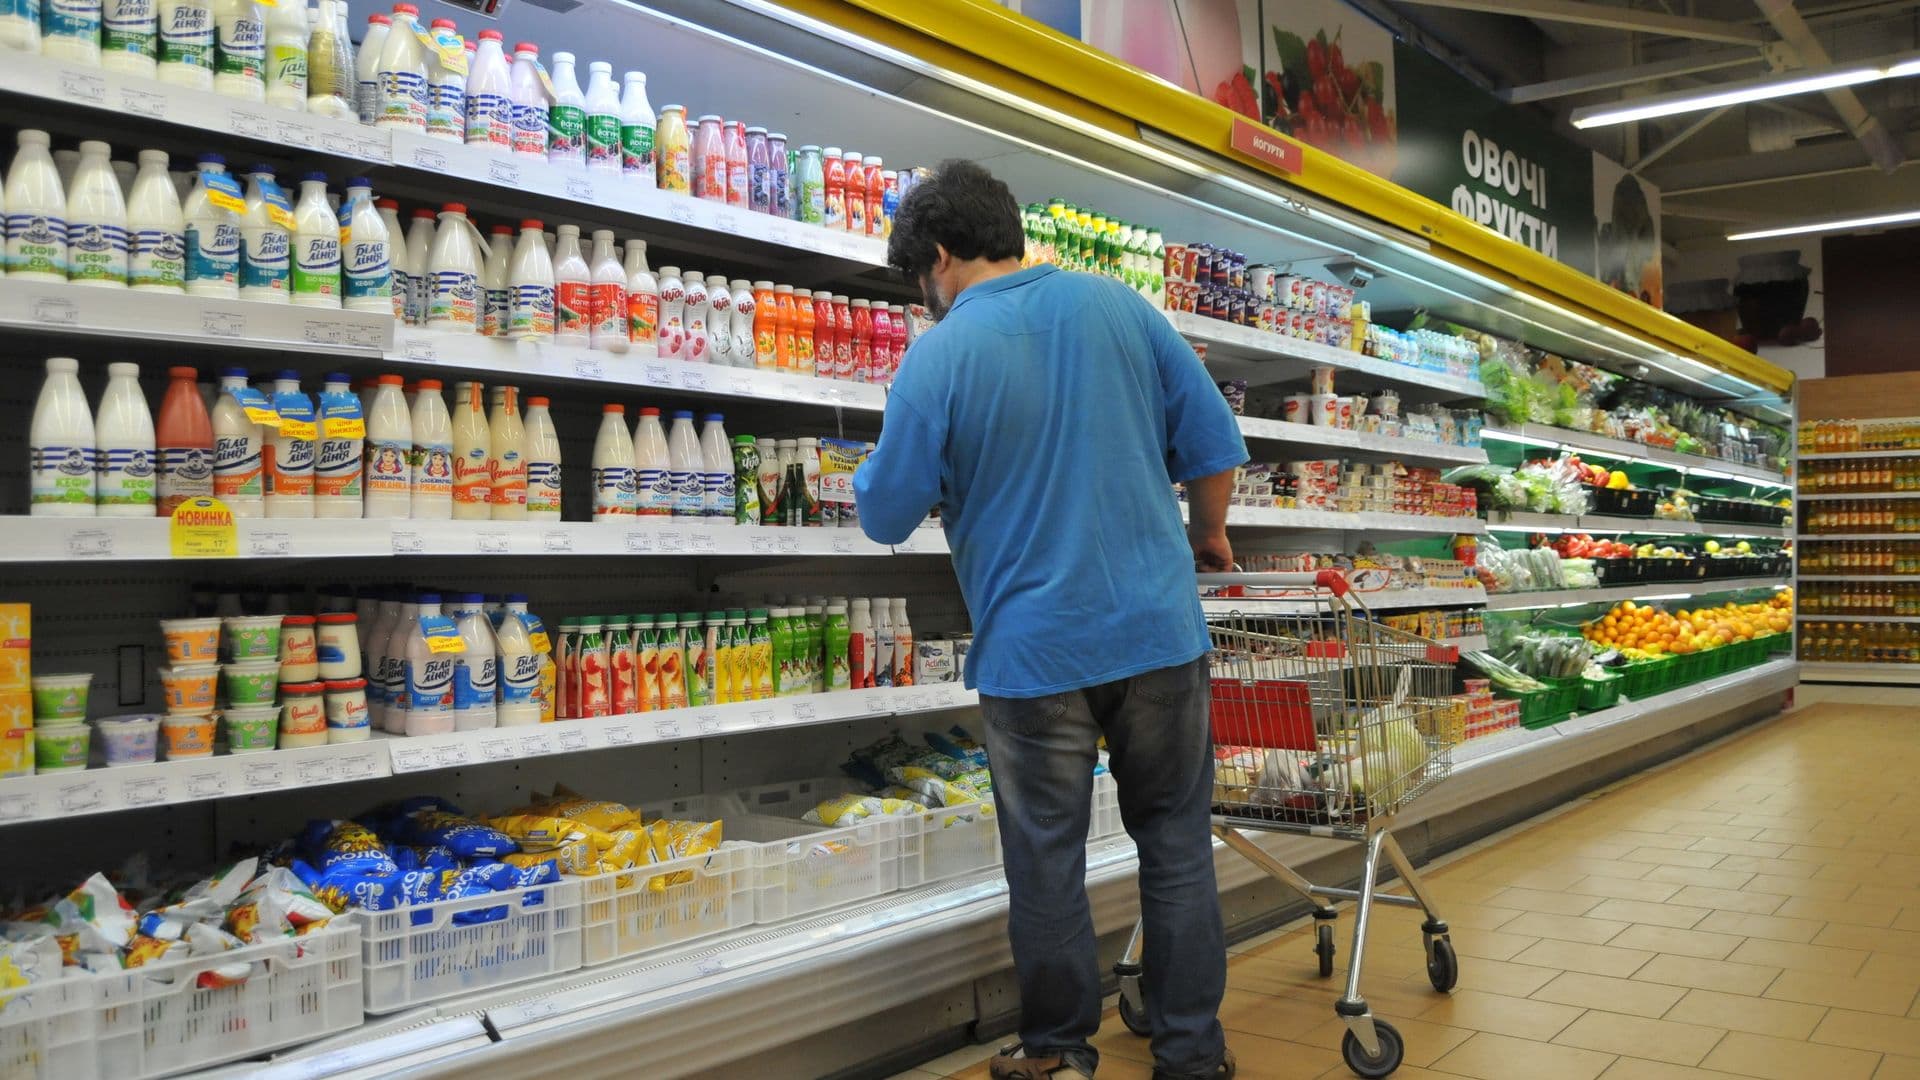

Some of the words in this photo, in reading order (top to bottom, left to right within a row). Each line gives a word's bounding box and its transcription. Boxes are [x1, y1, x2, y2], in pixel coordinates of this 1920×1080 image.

[1253, 136, 1285, 160] ЙОГУРТИ
[1463, 130, 1547, 209] ОВОЧІ
[263, 232, 289, 244] Біла
[20, 244, 58, 257] КЕФІР
[259, 243, 288, 256] лінія
[310, 239, 338, 251] Біла
[354, 243, 384, 256] Біла
[75, 252, 113, 265] КЕФІР
[307, 250, 337, 262] лінія
[353, 254, 383, 268] лінія
[151, 259, 184, 273] КЕФІР
[217, 438, 249, 452] Біла
[321, 440, 352, 453] Біла
[215, 449, 248, 462] лінія
[319, 451, 351, 464] лінія
[177, 510, 233, 527] НОВИНКА
[426, 660, 452, 674] Біла
[925, 658, 950, 668] Actimel
[423, 671, 452, 684] лінія
